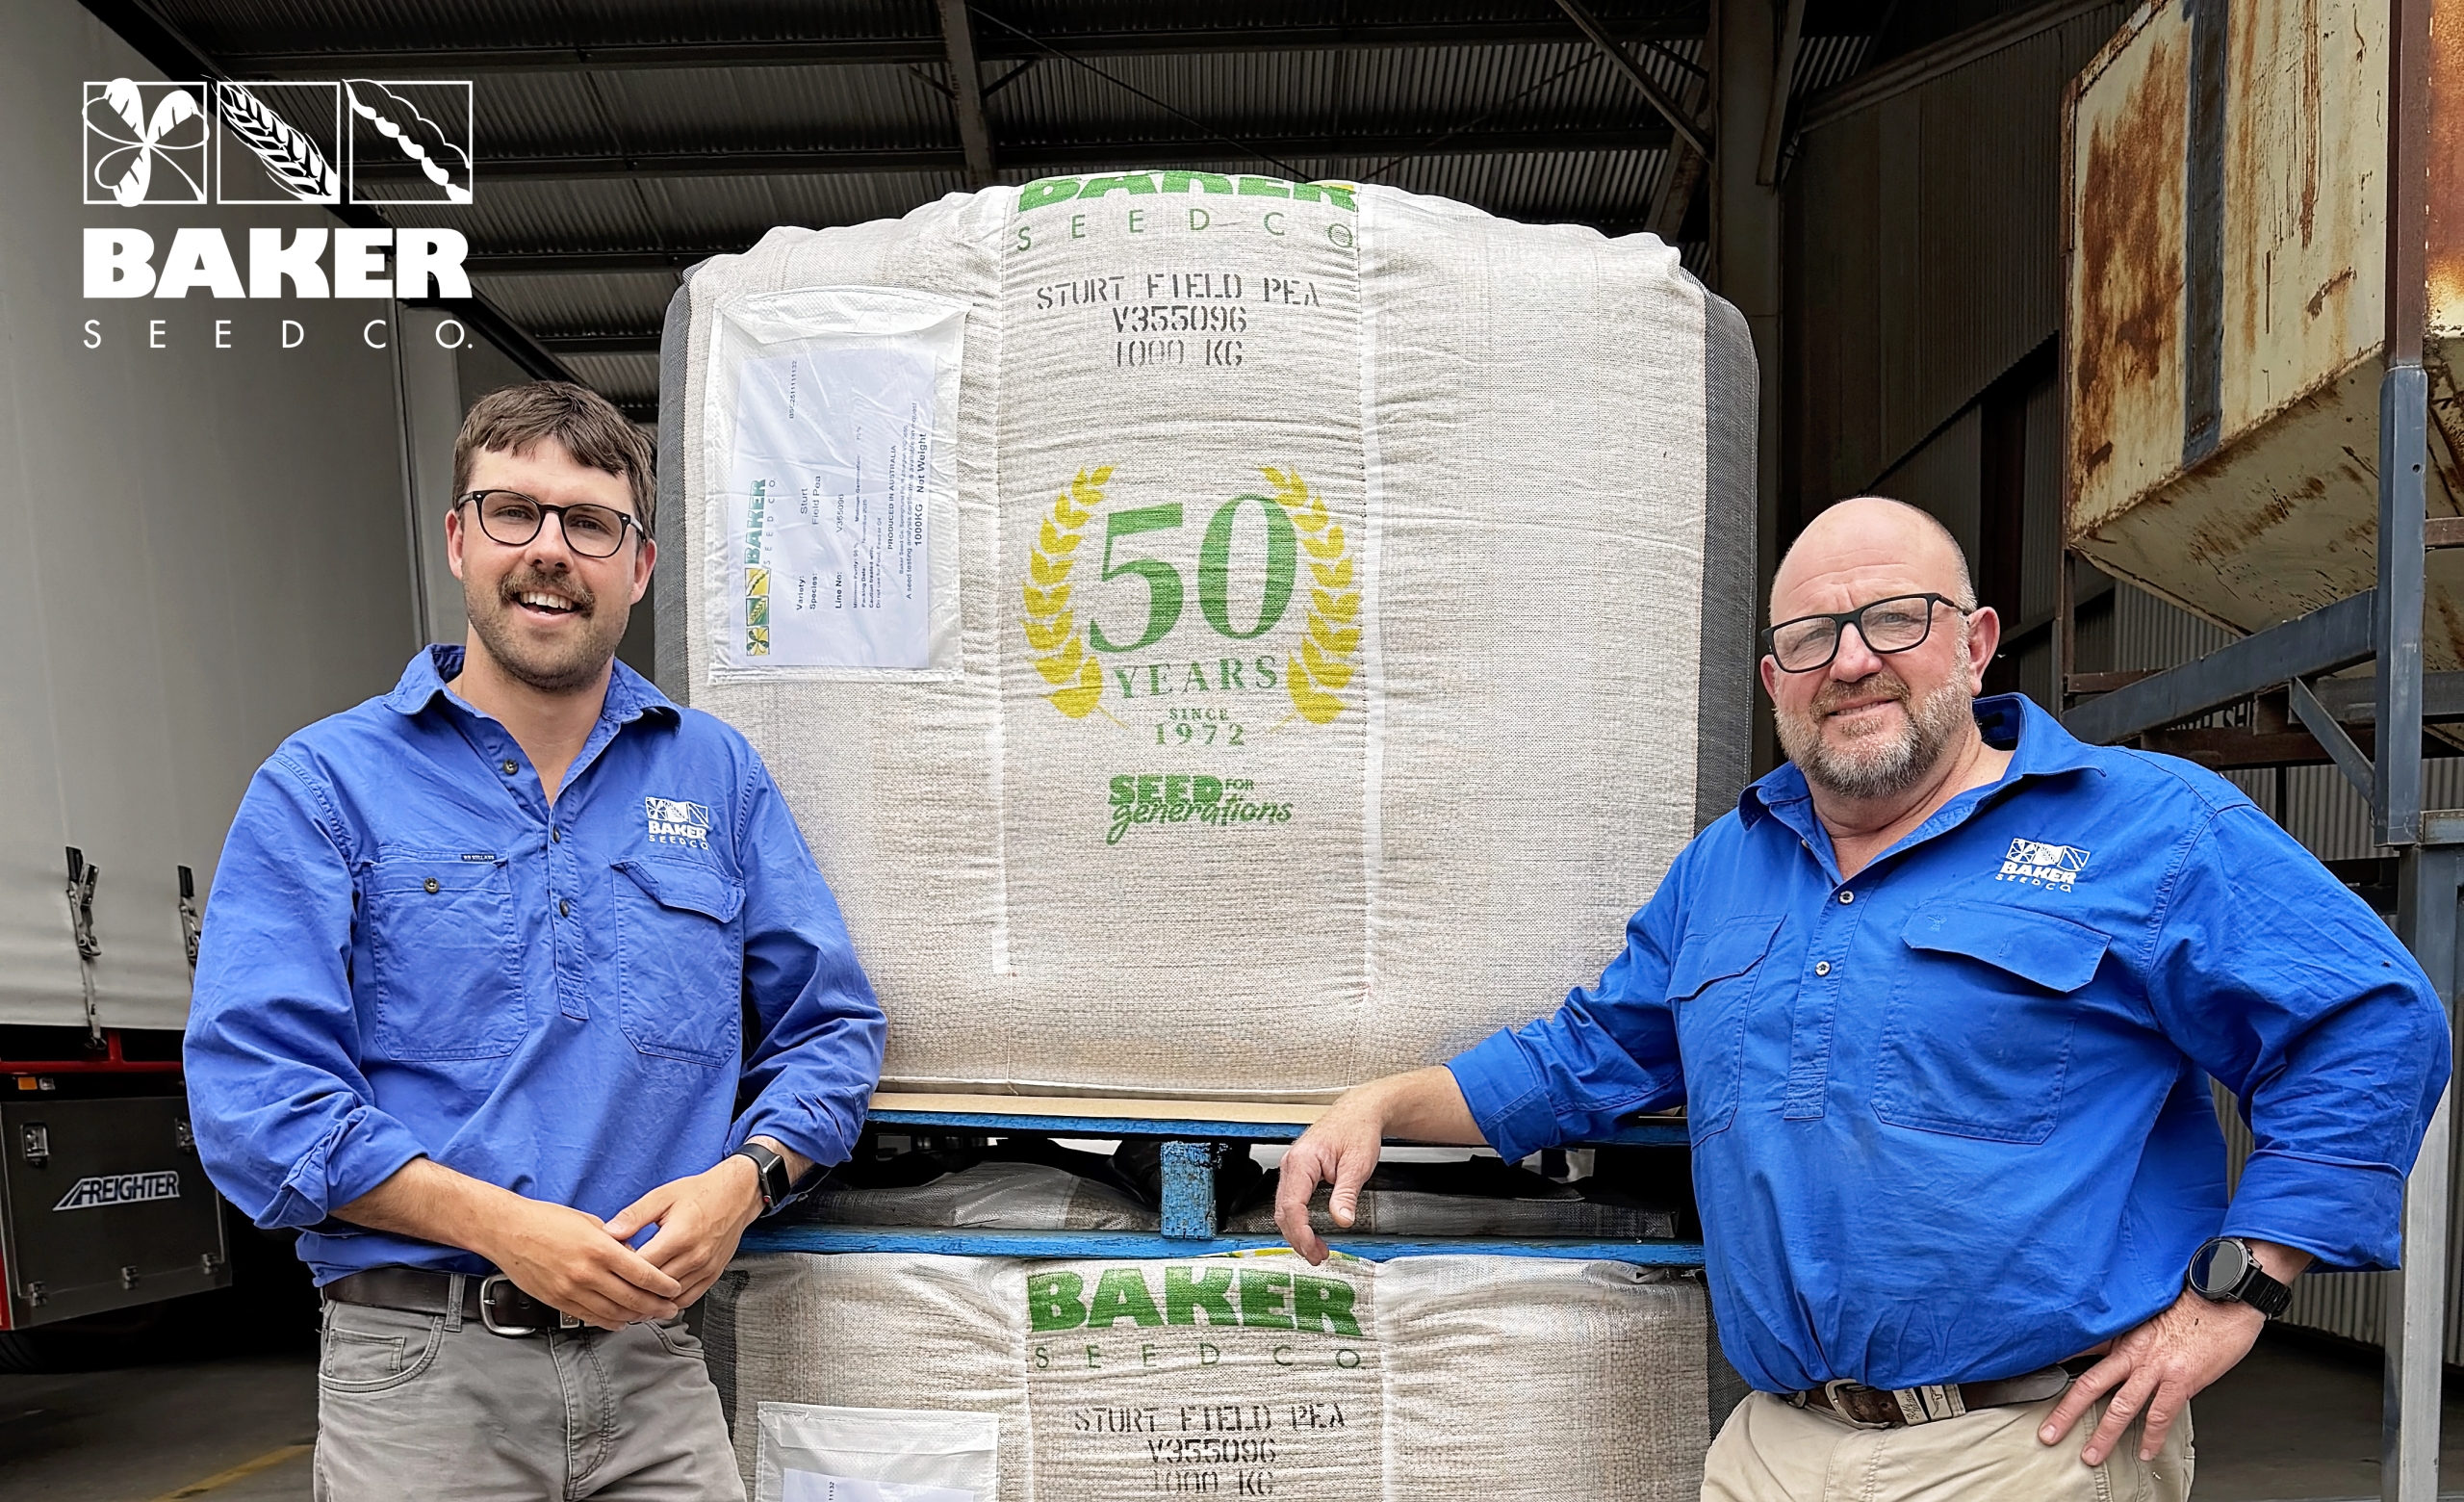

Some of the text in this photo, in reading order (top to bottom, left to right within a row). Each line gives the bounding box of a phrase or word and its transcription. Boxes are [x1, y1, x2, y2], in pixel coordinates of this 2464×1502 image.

[1017, 209, 1210, 251] SEED
[1037, 273, 1321, 310] STURT FIELD PEA
[1113, 305, 1246, 333] V355096
[1116, 339, 1243, 367] 1000 KG
[888, 493, 895, 502] IN
[914, 433, 928, 546] 1000KG Net Weight
[743, 479, 766, 564] BAKER
[796, 488, 808, 610] Variety: Sturt
[809, 476, 821, 610] Species: Field Pea
[1090, 494, 1297, 653] 50
[1112, 656, 1278, 699] YEARS
[1169, 707, 1229, 721] SINCE
[1155, 723, 1245, 746] 1972
[1108, 774, 1254, 806] SEED FOR
[648, 820, 707, 842] BAKER
[1106, 793, 1294, 846] generations
[649, 834, 686, 845] SEED
[1994, 873, 2041, 886] SEED
[1999, 860, 2077, 885] BAKER
[62, 1172, 179, 1208] FREIGHTER
[1027, 1265, 1363, 1337] BAKER
[1036, 1342, 1361, 1369] SEED CO
[1074, 1402, 1346, 1433] STURT FIELD PEA
[1147, 1437, 1276, 1463] V355096
[1154, 1468, 1273, 1495] 1000 KG
